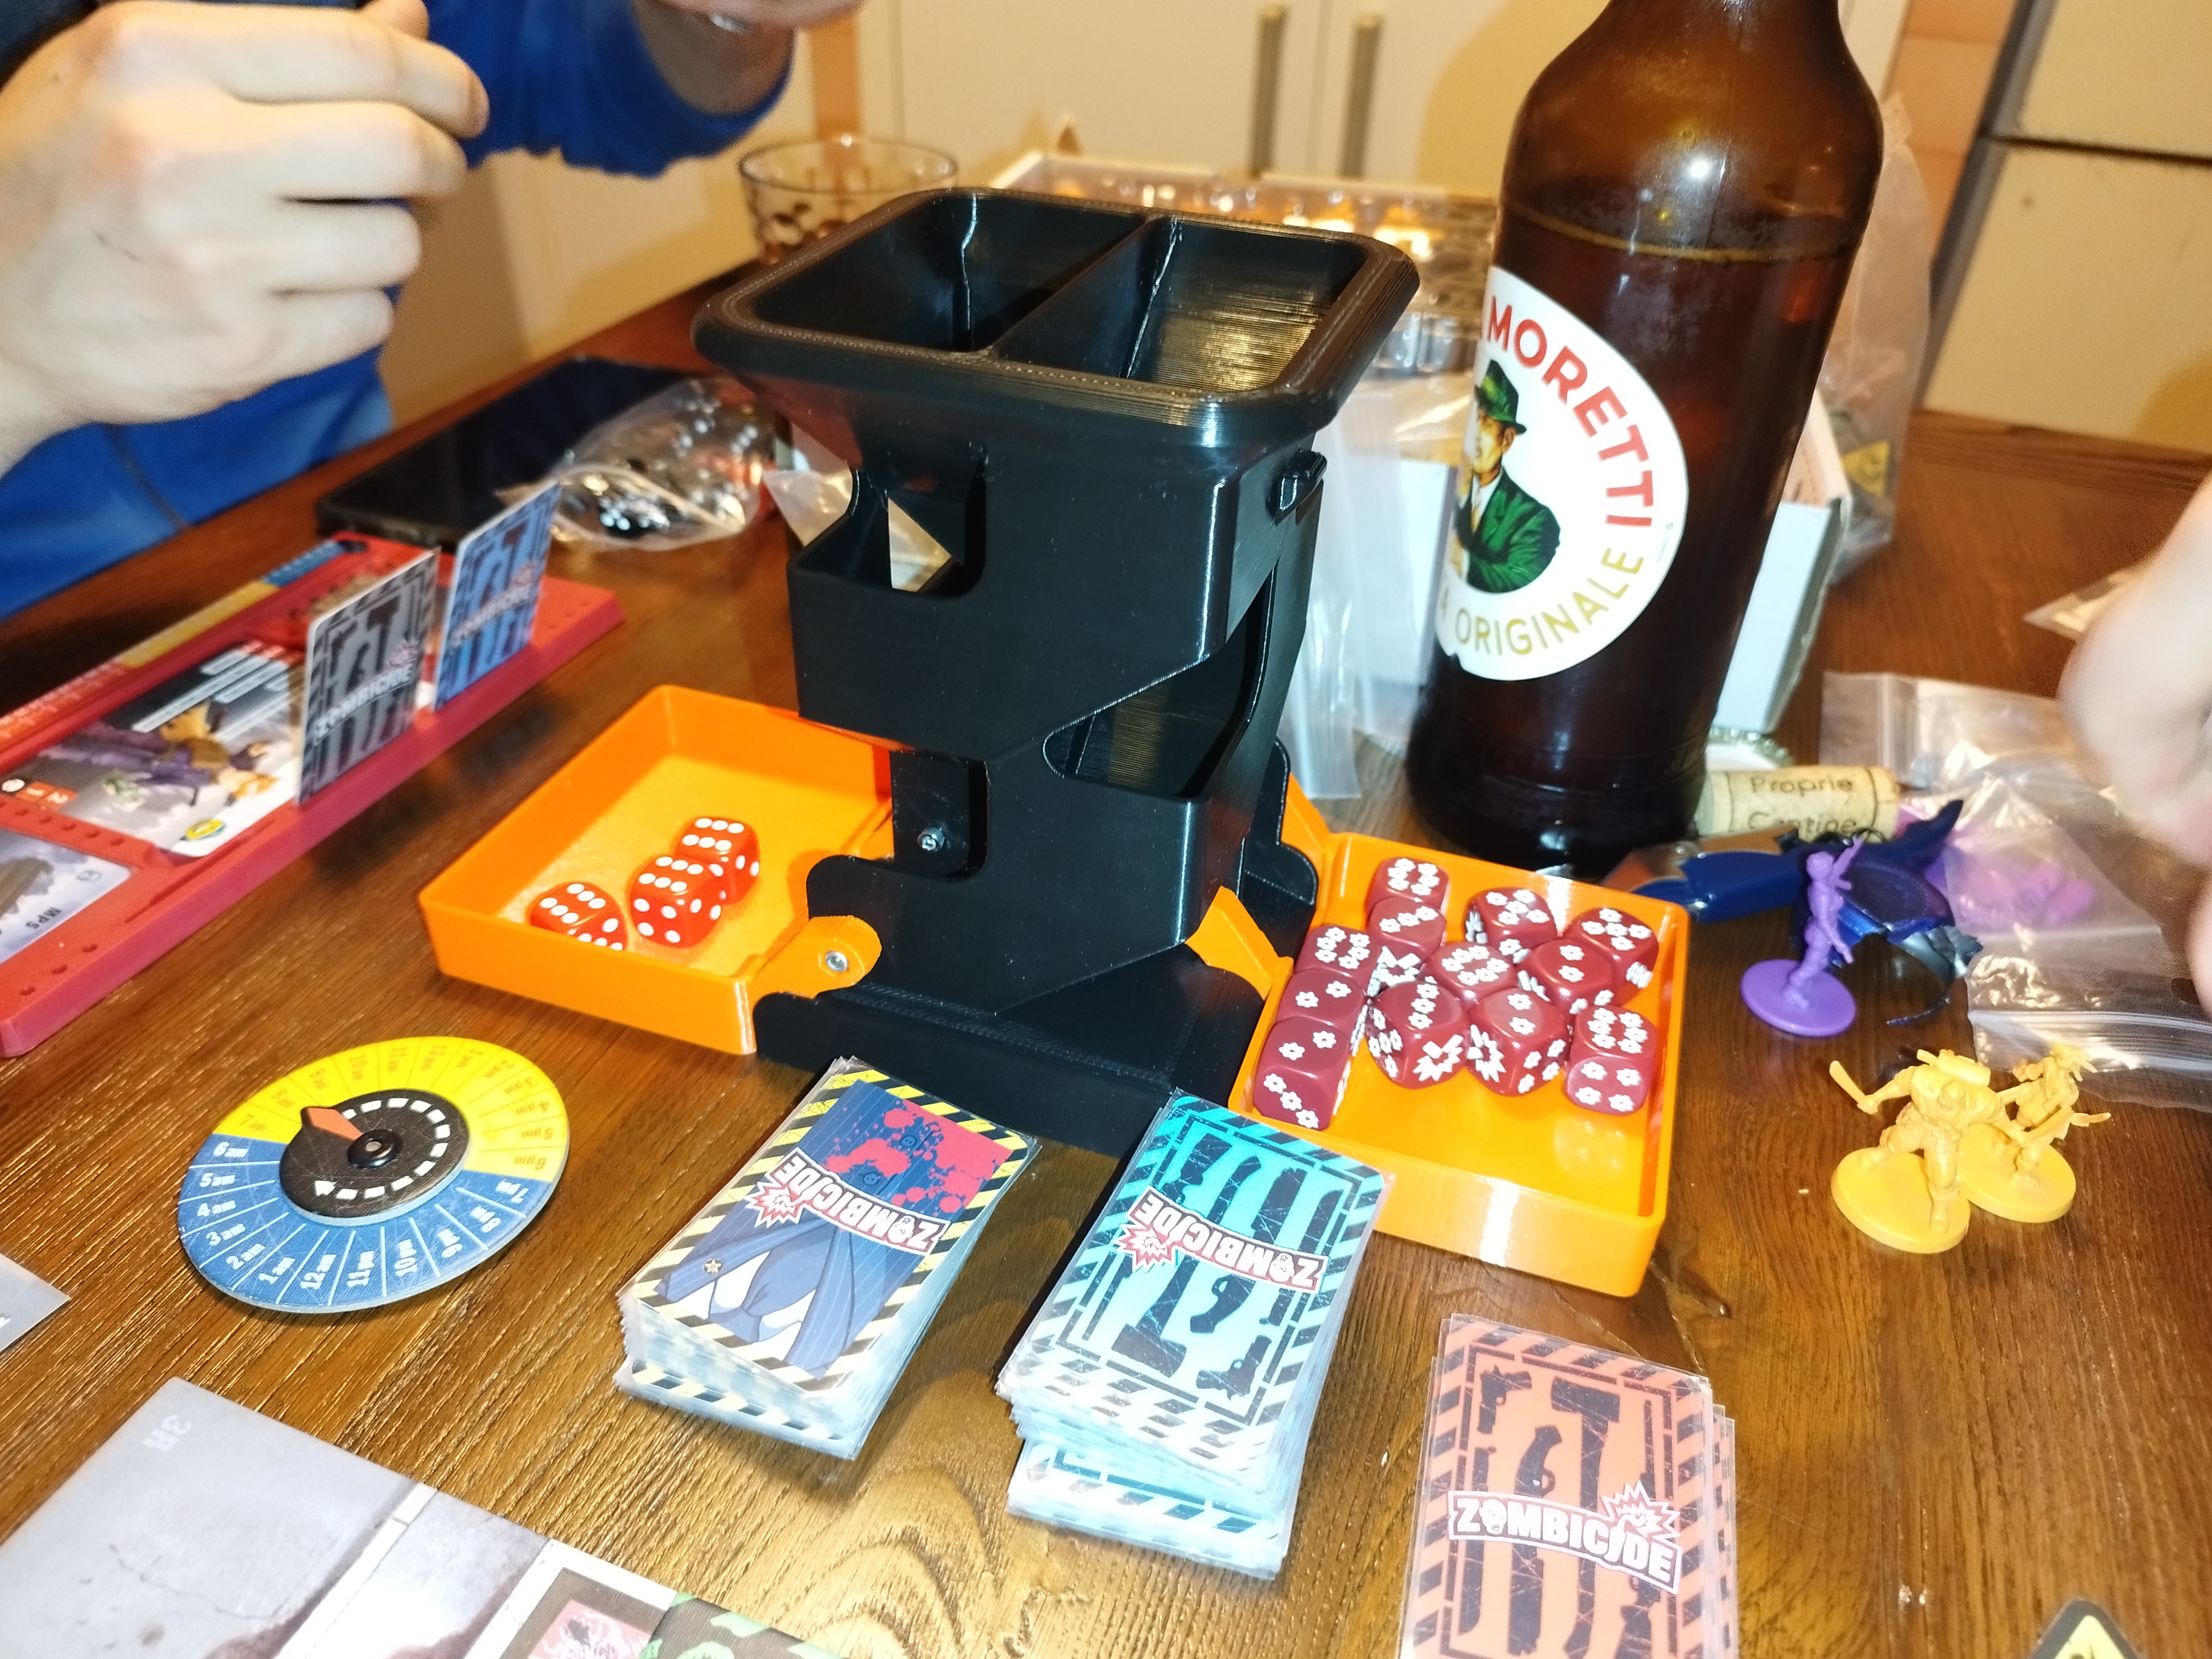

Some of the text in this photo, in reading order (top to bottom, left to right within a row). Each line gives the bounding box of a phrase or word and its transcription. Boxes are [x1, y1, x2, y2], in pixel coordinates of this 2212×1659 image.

[1488, 296, 1654, 528] MORETTI
[1455, 547, 1645, 656] ORIGINALE
[1750, 777, 1853, 797] Proprie
[774, 1155, 941, 1250] ZOMBICIDE
[1134, 1193, 1324, 1287] ZOMBICIDE
[1456, 1498, 1674, 1583] ZOMBICIDE
